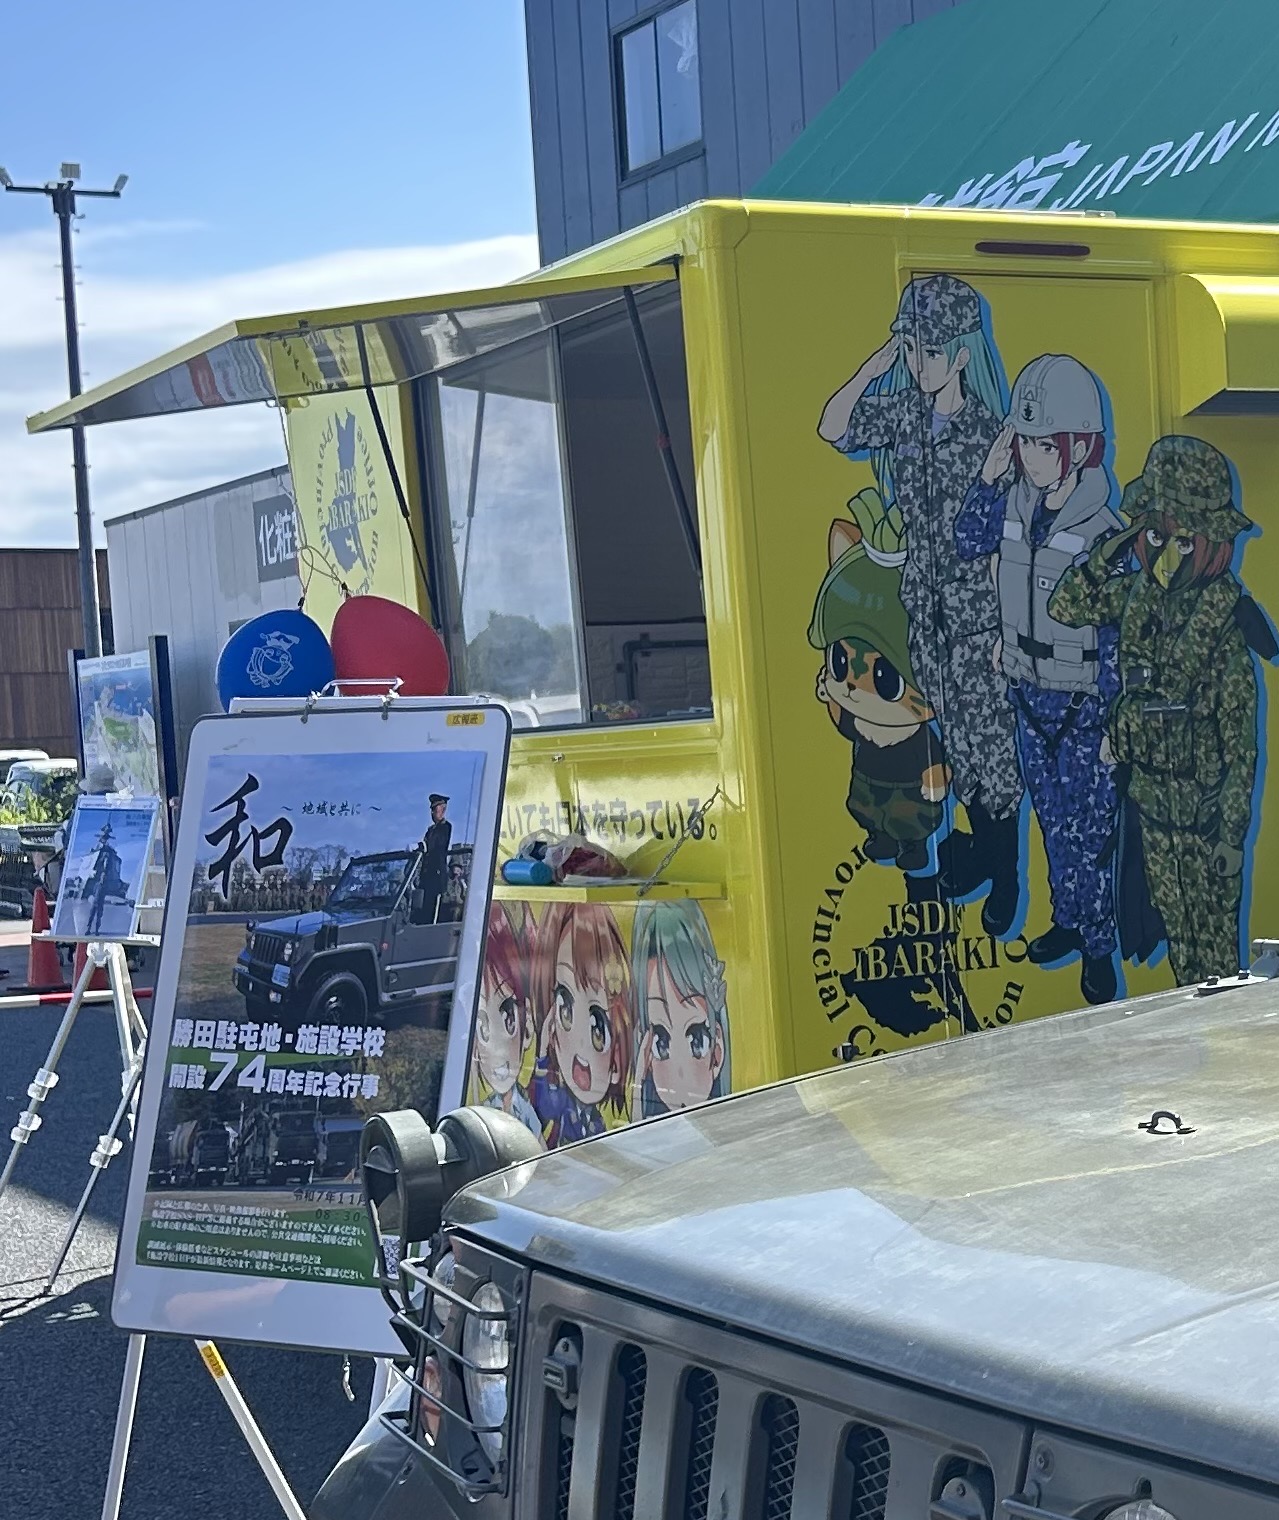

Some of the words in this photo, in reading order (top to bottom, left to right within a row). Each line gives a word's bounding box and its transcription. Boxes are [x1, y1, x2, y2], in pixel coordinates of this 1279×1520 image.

[1050, 111, 1260, 211] JAPAN
[328, 492, 370, 532] IBARAKI
[204, 773, 294, 900] 和
[501, 797, 718, 844] いても日本を守っている。
[811, 845, 868, 1024] rovincial
[882, 899, 967, 938] JSDF
[852, 934, 1000, 983] IBARAKI
[171, 1018, 387, 1058] 勝田駐屯地・施設学校
